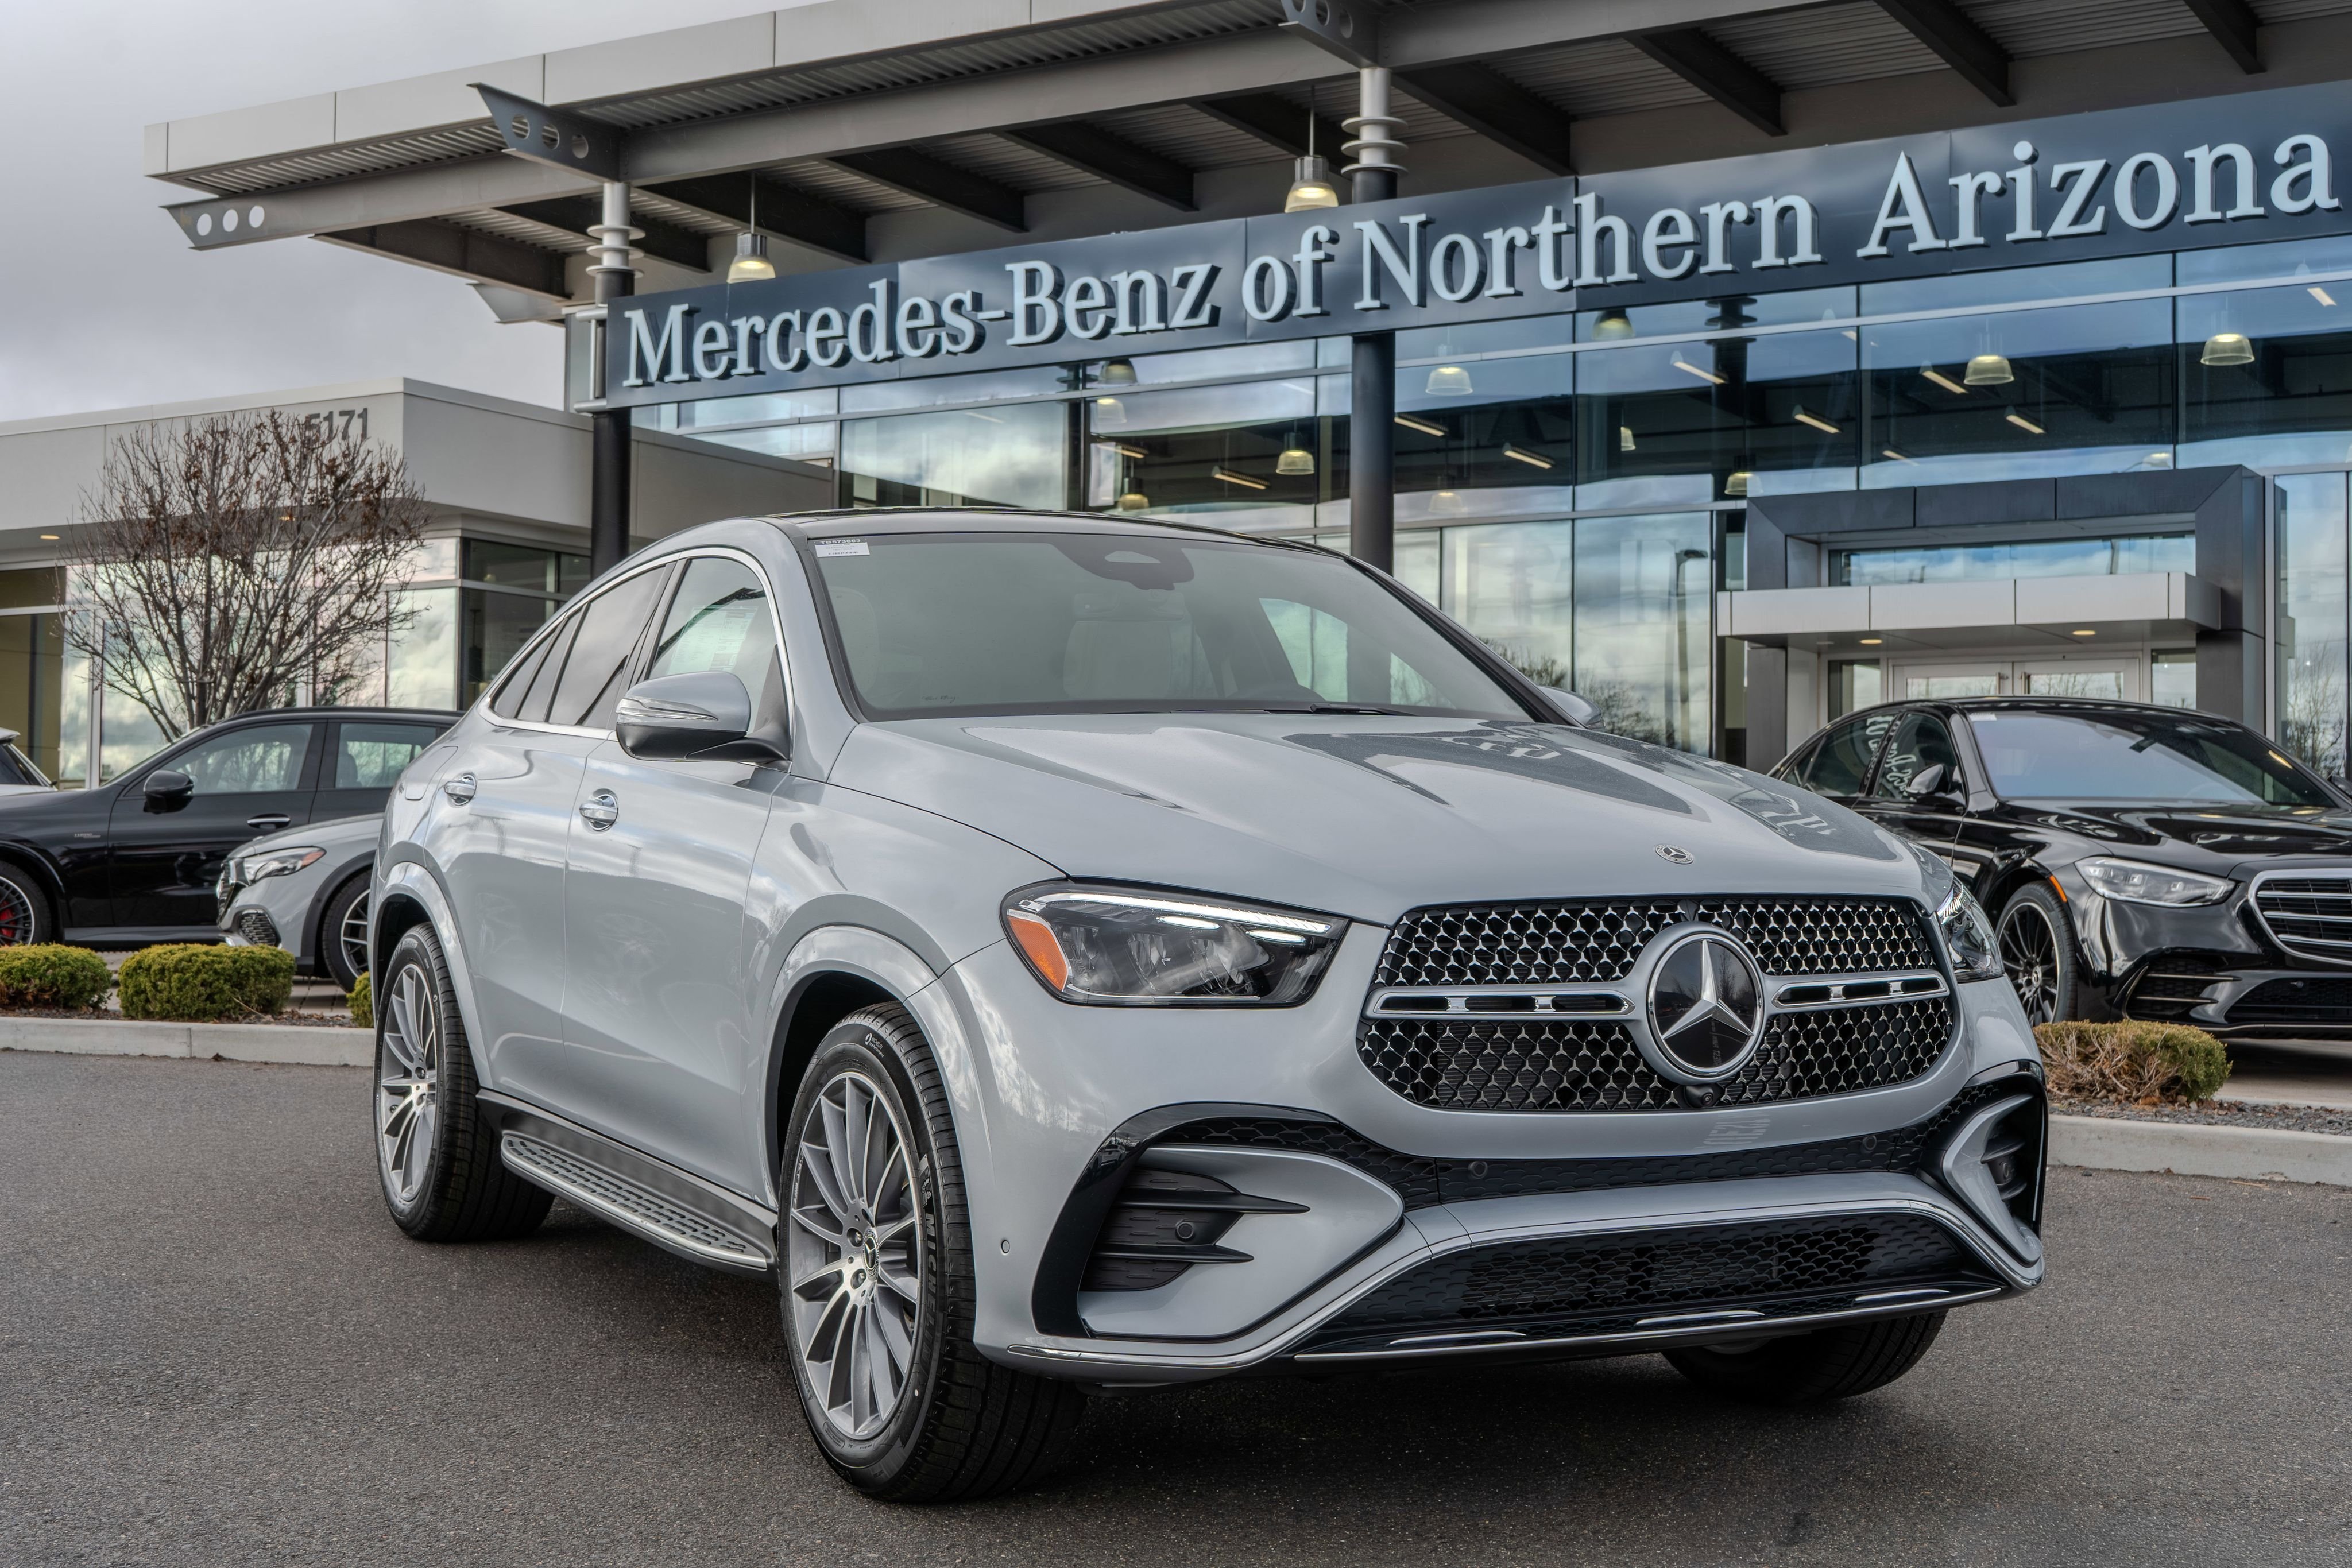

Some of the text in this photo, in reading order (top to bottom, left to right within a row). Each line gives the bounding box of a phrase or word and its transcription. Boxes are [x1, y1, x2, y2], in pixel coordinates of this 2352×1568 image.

[622, 134, 2340, 387] Mercedes-Benz of Northern Arizona
[305, 408, 368, 446] 5171
